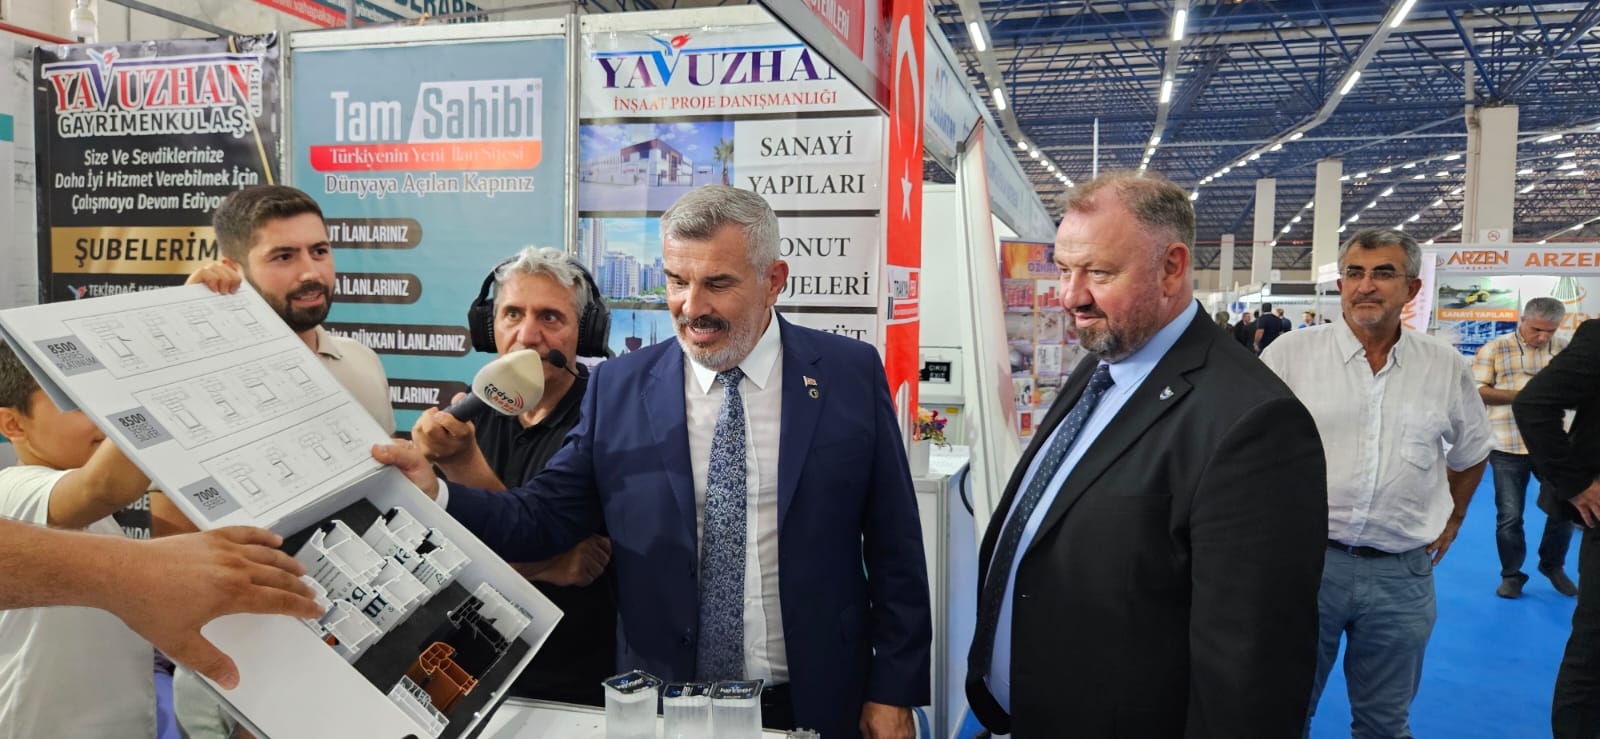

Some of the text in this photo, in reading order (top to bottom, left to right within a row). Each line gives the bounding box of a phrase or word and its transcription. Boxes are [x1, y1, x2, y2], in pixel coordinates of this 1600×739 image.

[45, 57, 258, 112] YAVUZHAN
[613, 90, 837, 112] İNŞAAT PROJE DANIŞMANLIĞI
[60, 109, 207, 136] GAYRİMENKUL
[330, 84, 535, 142] Tam Sahibi
[760, 130, 853, 158] SANAYİ
[84, 146, 224, 166] Size Ve Sevdiklerinize
[330, 148, 408, 167] Türkiyenin
[412, 147, 444, 163] Yeni
[482, 146, 524, 163] Sitesi
[55, 166, 258, 190] Daha İyi Hizmet Verebilmek İçin
[325, 172, 534, 199] Dünyaya Açılan Kapınız
[748, 174, 866, 195] YAPILARI
[72, 194, 134, 214] Çalışmaya
[137, 193, 178, 210] Devam
[341, 223, 408, 242] İLANLARINIZ
[1447, 250, 1510, 265] ARZEN
[89, 281, 135, 297] TEKİRDAĞ
[343, 276, 409, 296] İLANLARINIZ
[47, 341, 77, 354] 8500
[397, 330, 465, 351] İLANLARINIZ
[488, 383, 514, 404] radyo
[118, 413, 146, 427] 8500
[193, 487, 219, 502] 7000
